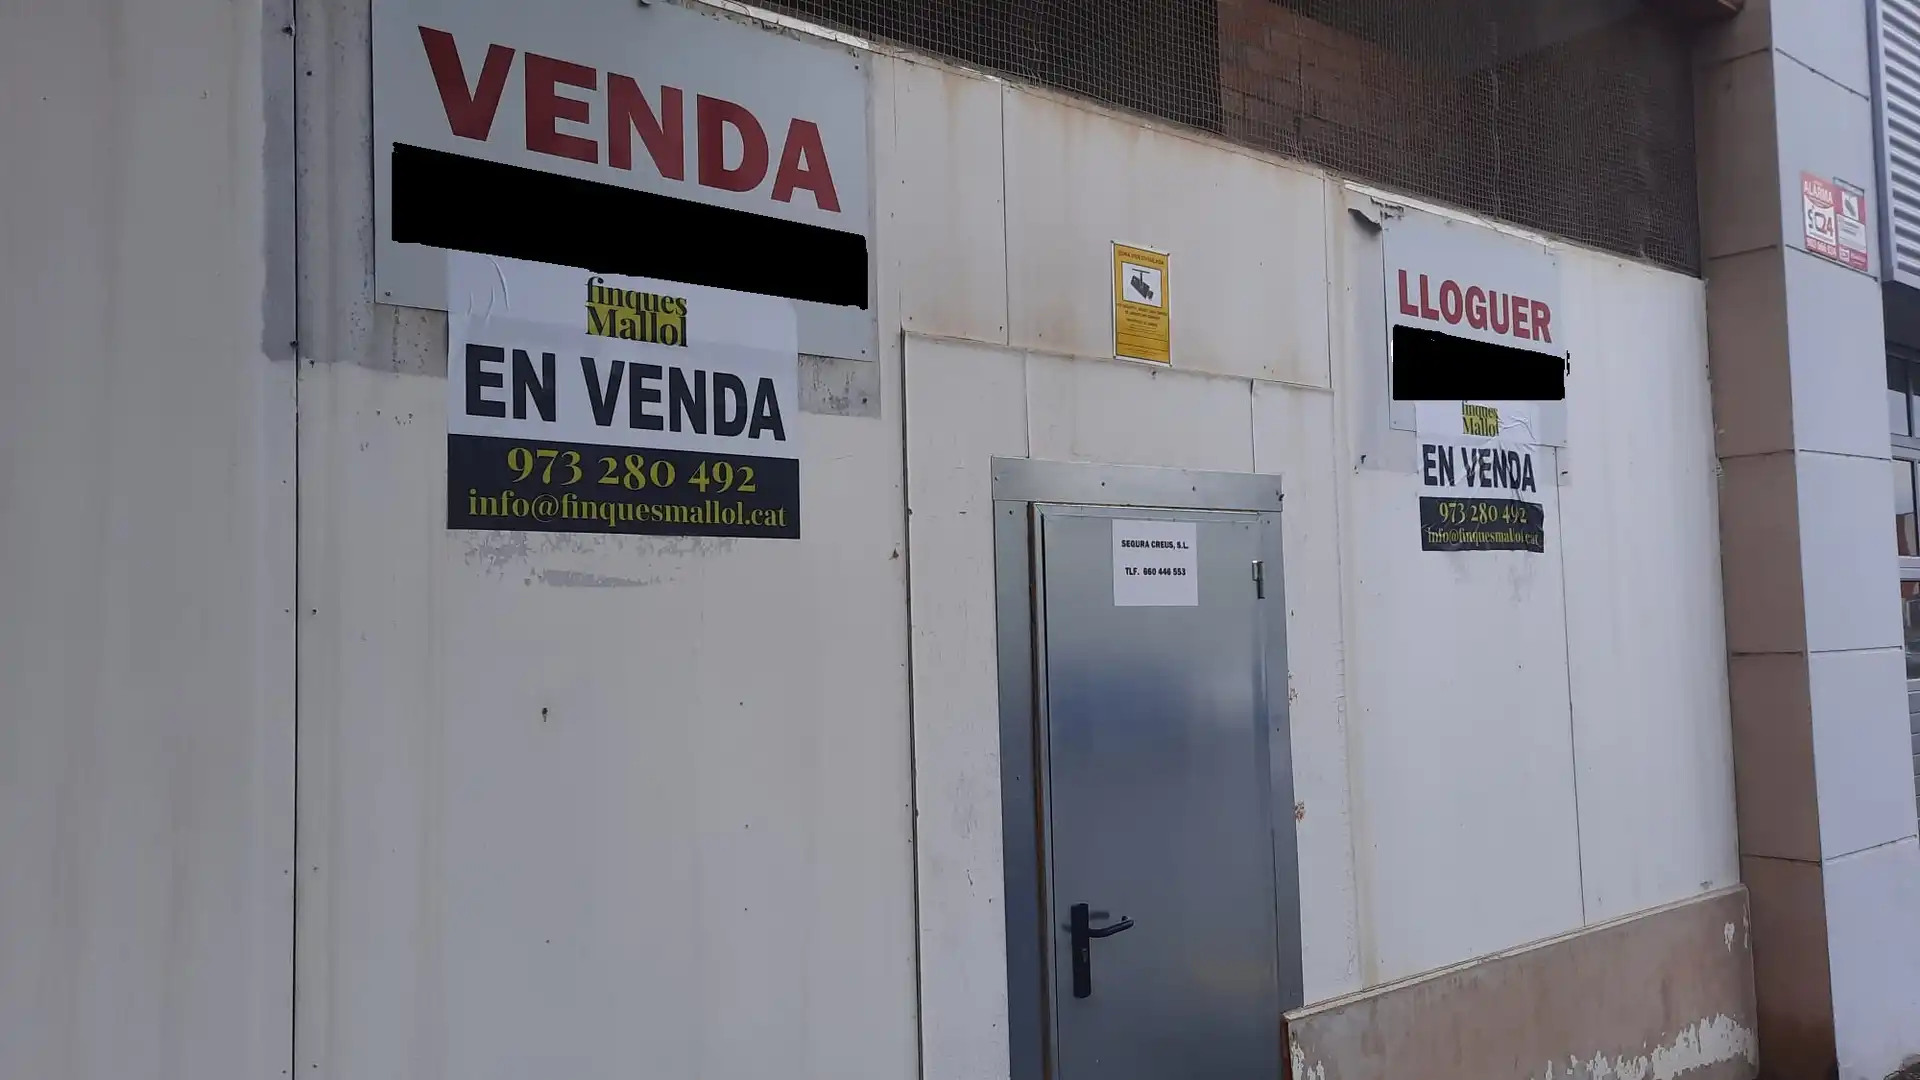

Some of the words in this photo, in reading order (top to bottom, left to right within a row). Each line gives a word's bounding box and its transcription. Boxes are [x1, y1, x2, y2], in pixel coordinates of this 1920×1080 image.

[418, 25, 841, 213] VENDA
[1803, 180, 1834, 204] ALARMA
[585, 276, 688, 318] finques
[1398, 269, 1552, 344] LLOGUER
[585, 305, 688, 347] Mallol
[465, 343, 557, 423] EN
[580, 356, 786, 441] VENDA
[507, 447, 583, 486] 973
[597, 456, 676, 491] 280
[688, 460, 757, 493] 492
[1422, 444, 1455, 486] EN
[1461, 447, 1537, 493] VENDA
[468, 488, 787, 528] info@finquesmallol.cat
[1439, 503, 1466, 525] 973
[1471, 504, 1498, 524] 280
[1502, 505, 1528, 524] 492
[1121, 540, 1150, 549] SEGURA
[1151, 541, 1175, 550] CREUS,
[1176, 541, 1189, 549] S.L.
[1125, 567, 1140, 576] TLF.
[1173, 568, 1186, 576] 553
